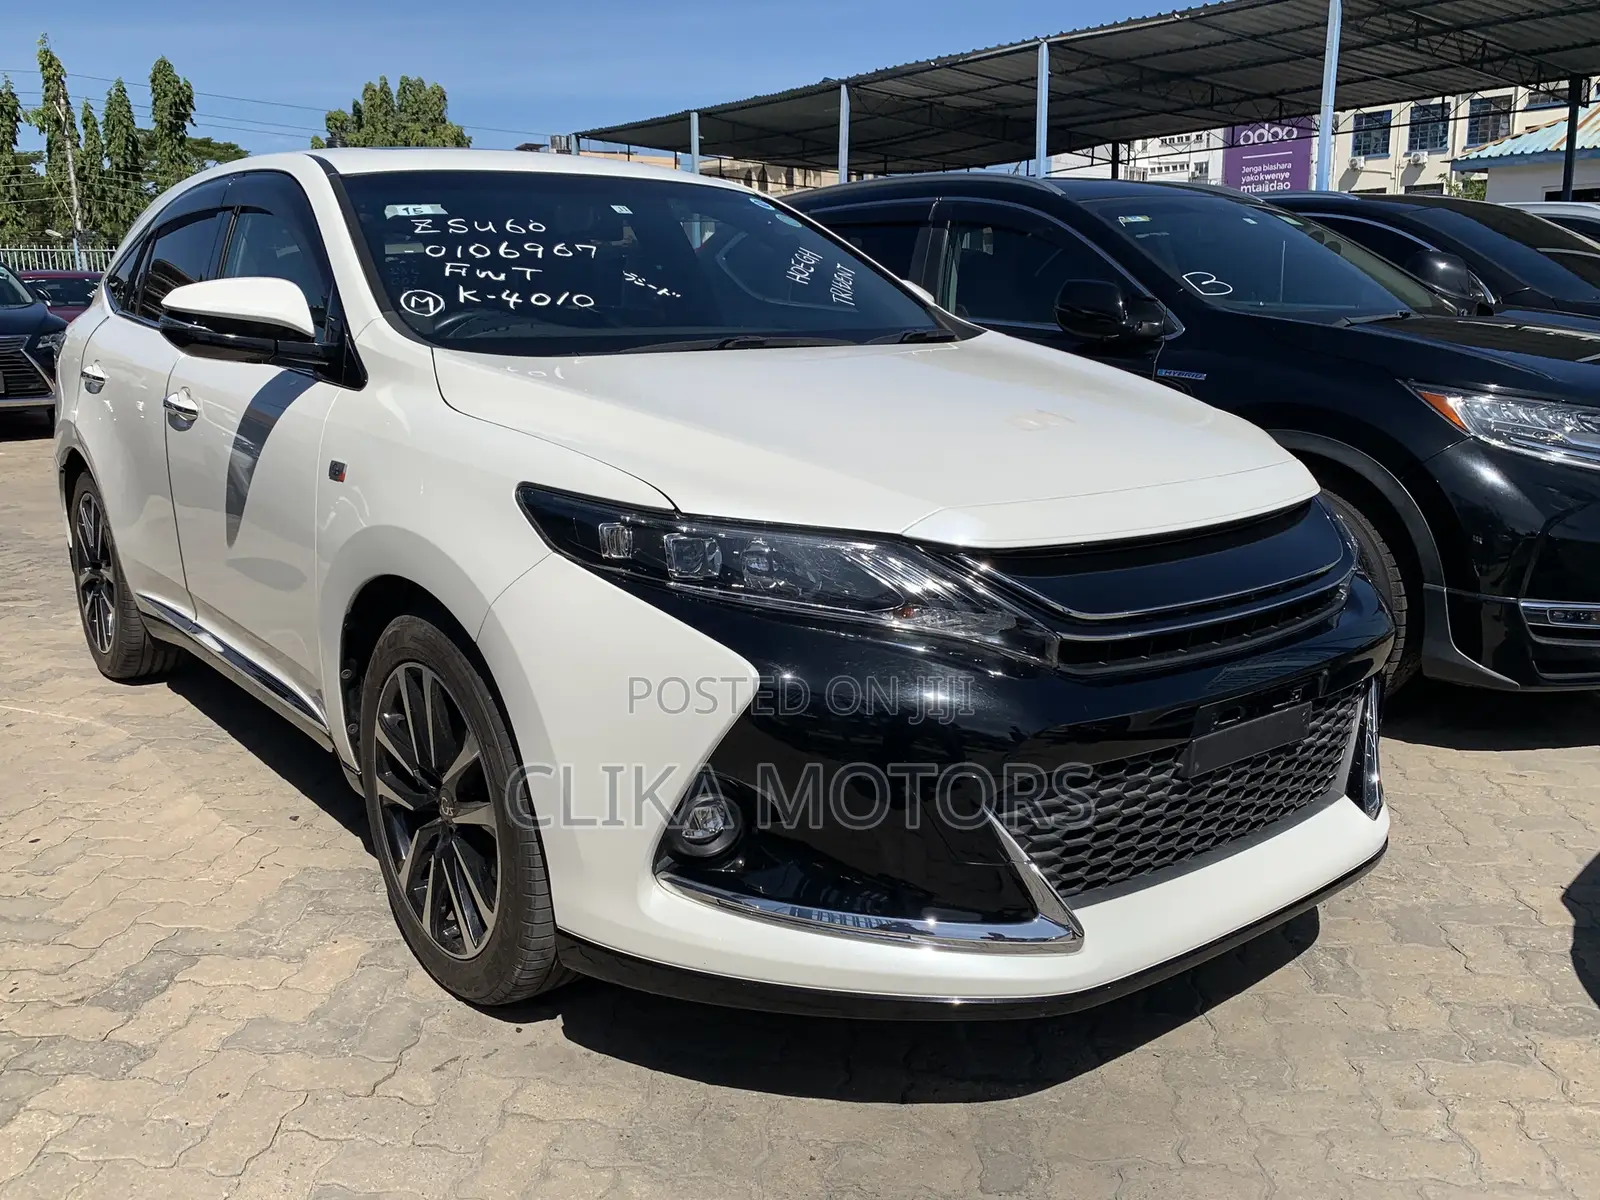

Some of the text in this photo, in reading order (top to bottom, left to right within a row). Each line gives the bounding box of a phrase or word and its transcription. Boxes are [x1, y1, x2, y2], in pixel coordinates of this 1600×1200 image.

[1239, 123, 1298, 148] odoo
[1241, 162, 1292, 174] Jenga biashara
[1241, 171, 1290, 184] yako kwenye
[410, 218, 546, 234] ZSU60
[786, 246, 824, 285] HOEGH
[458, 284, 595, 310] K-4010
